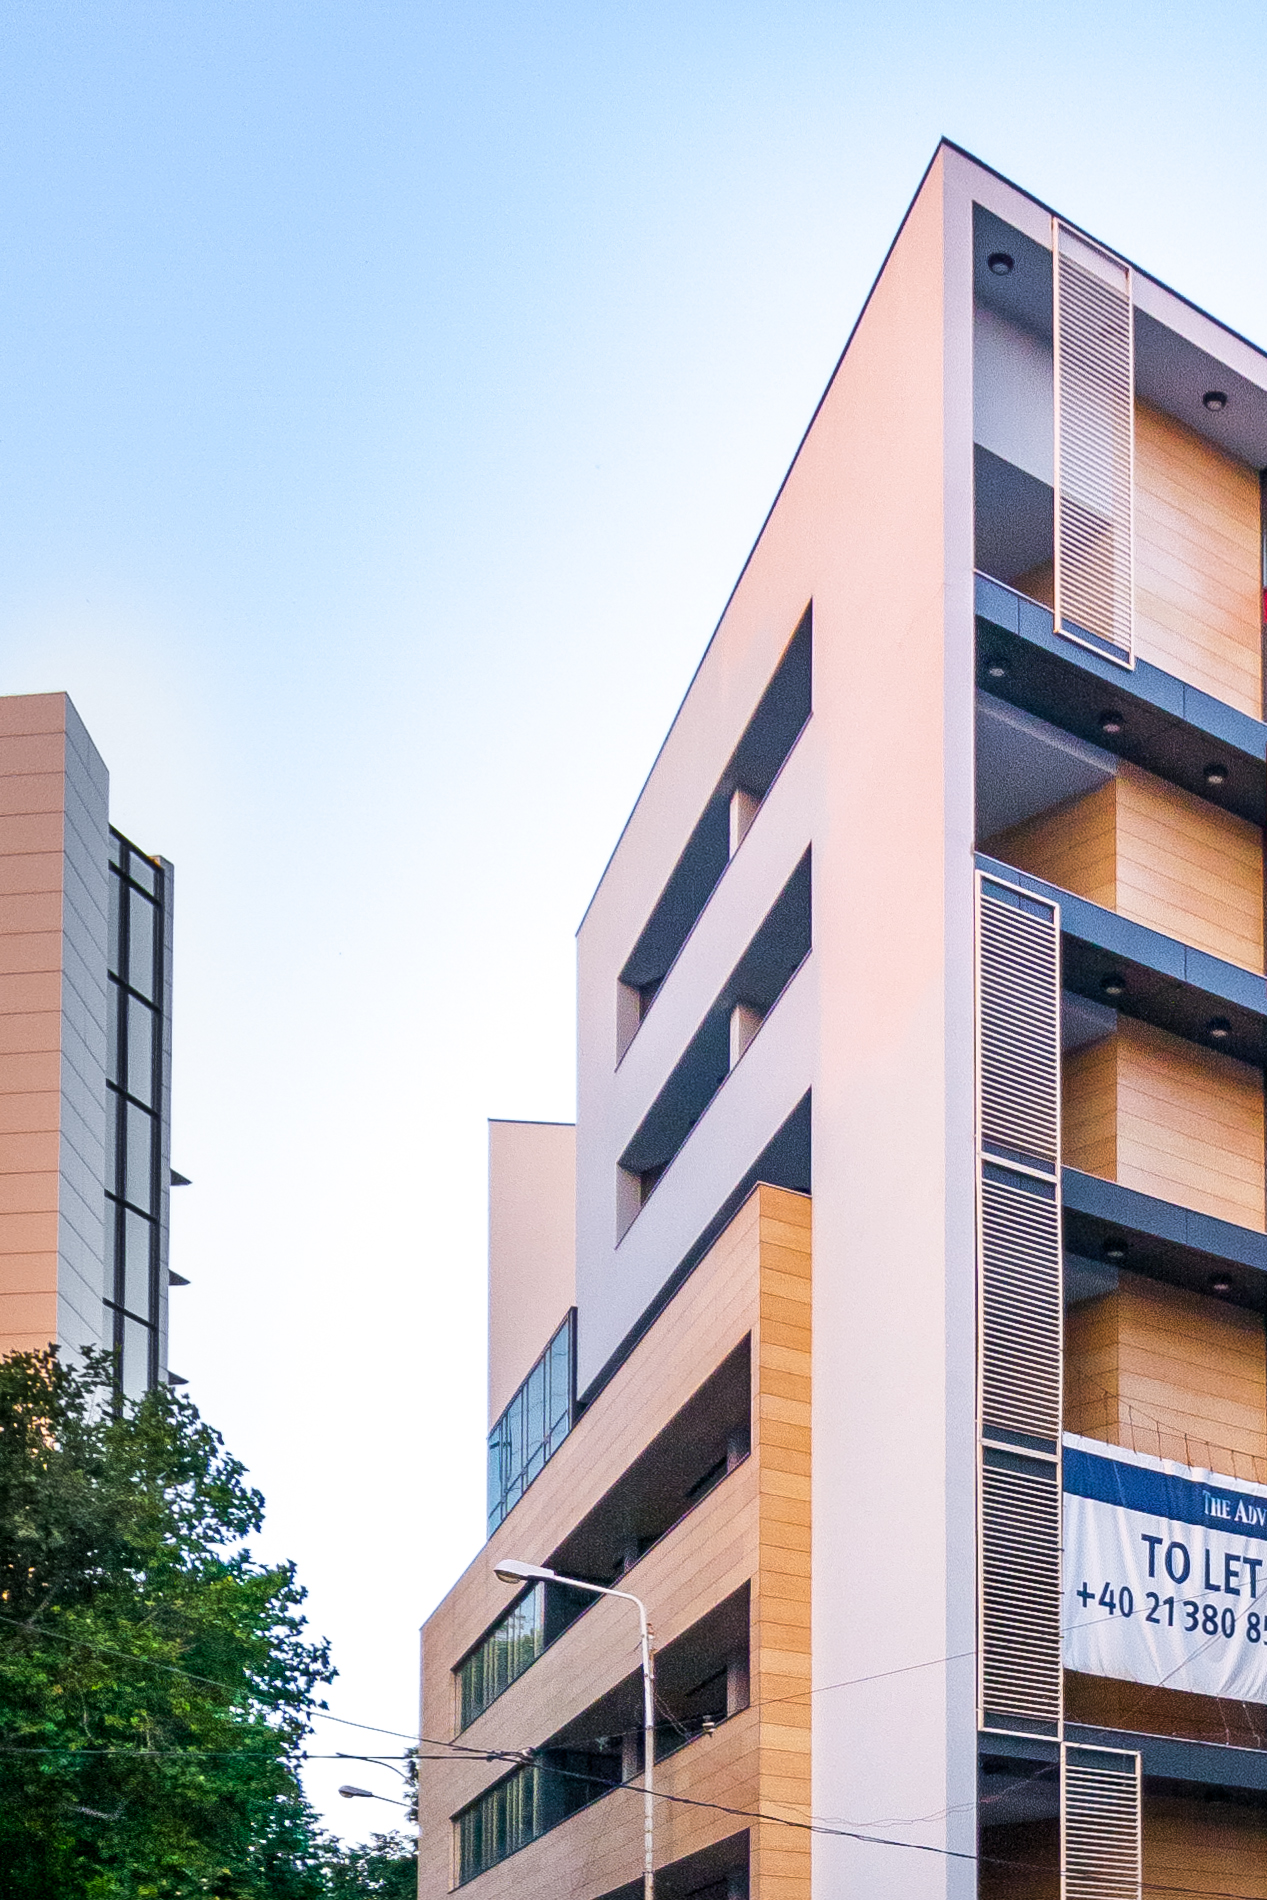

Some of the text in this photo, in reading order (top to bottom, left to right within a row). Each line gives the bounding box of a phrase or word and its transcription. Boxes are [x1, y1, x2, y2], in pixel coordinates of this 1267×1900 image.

[1202, 1489, 1231, 1520] THE
[1141, 1533, 1263, 1599] TO LET
[1076, 1581, 1134, 1618] +40
